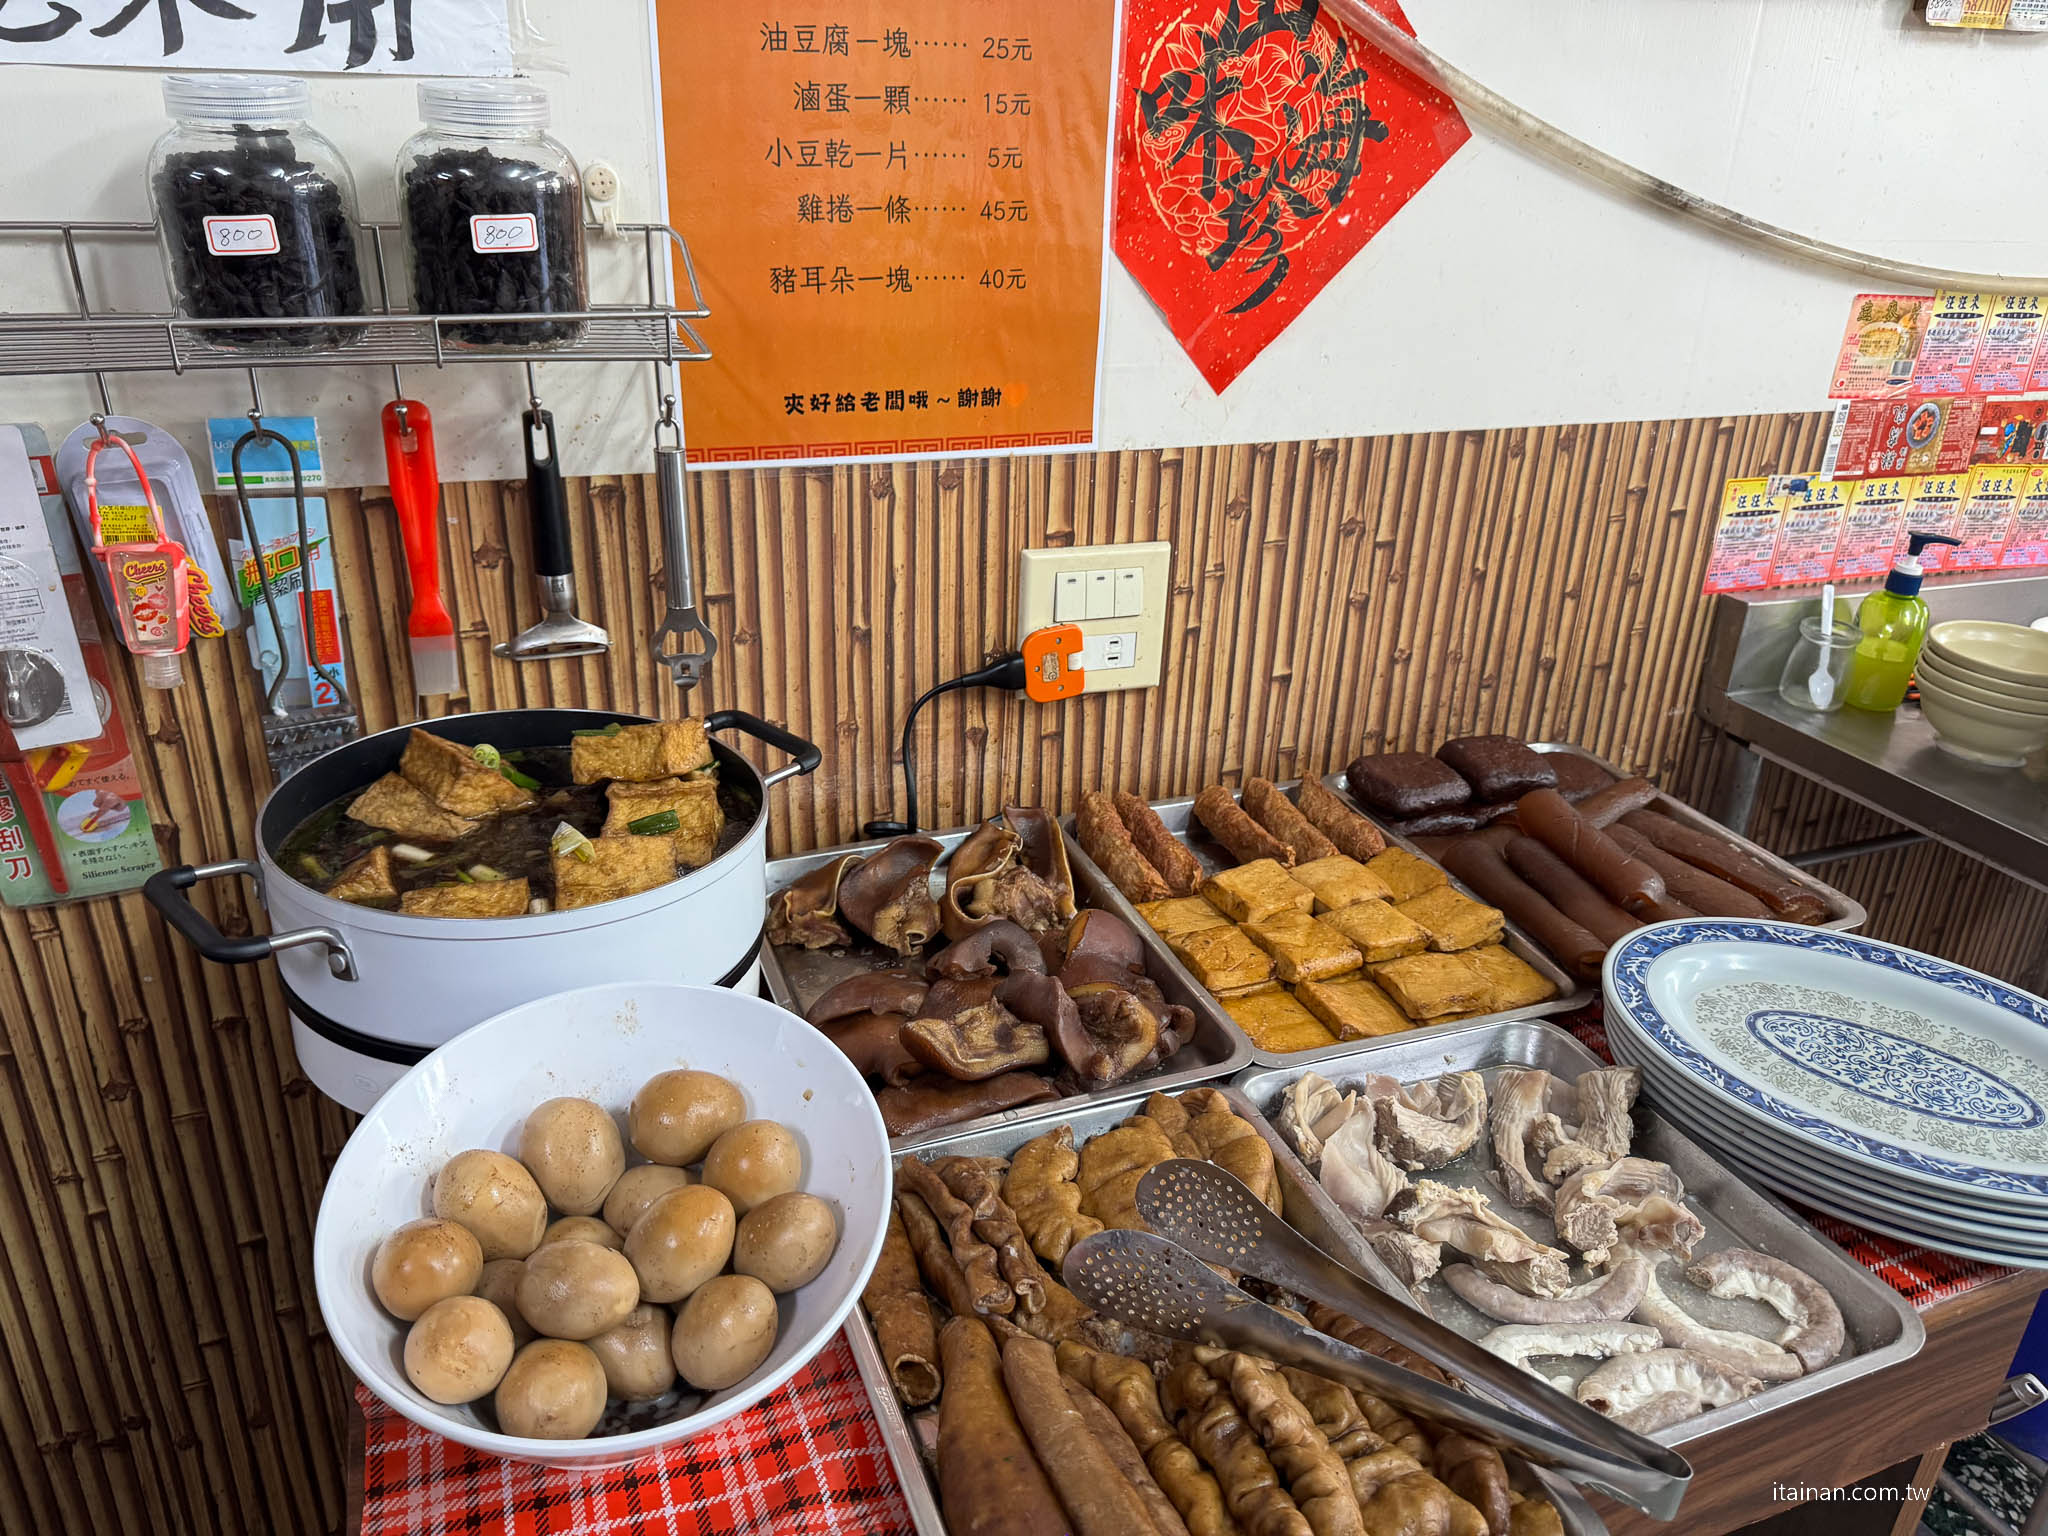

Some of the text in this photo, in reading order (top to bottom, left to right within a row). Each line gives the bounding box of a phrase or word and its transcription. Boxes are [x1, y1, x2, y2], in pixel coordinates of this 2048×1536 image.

[981, 36, 1033, 62] 25元
[983, 92, 1032, 116] 15元
[987, 147, 1024, 170] 5元
[980, 200, 1029, 223] 45元
[219, 228, 262, 246] 800
[484, 226, 523, 244] 800
[979, 268, 1027, 290] 40元
[125, 561, 167, 578] Cheers
[187, 568, 220, 635] Cheers
[82, 861, 156, 880] Silicone Scraper
